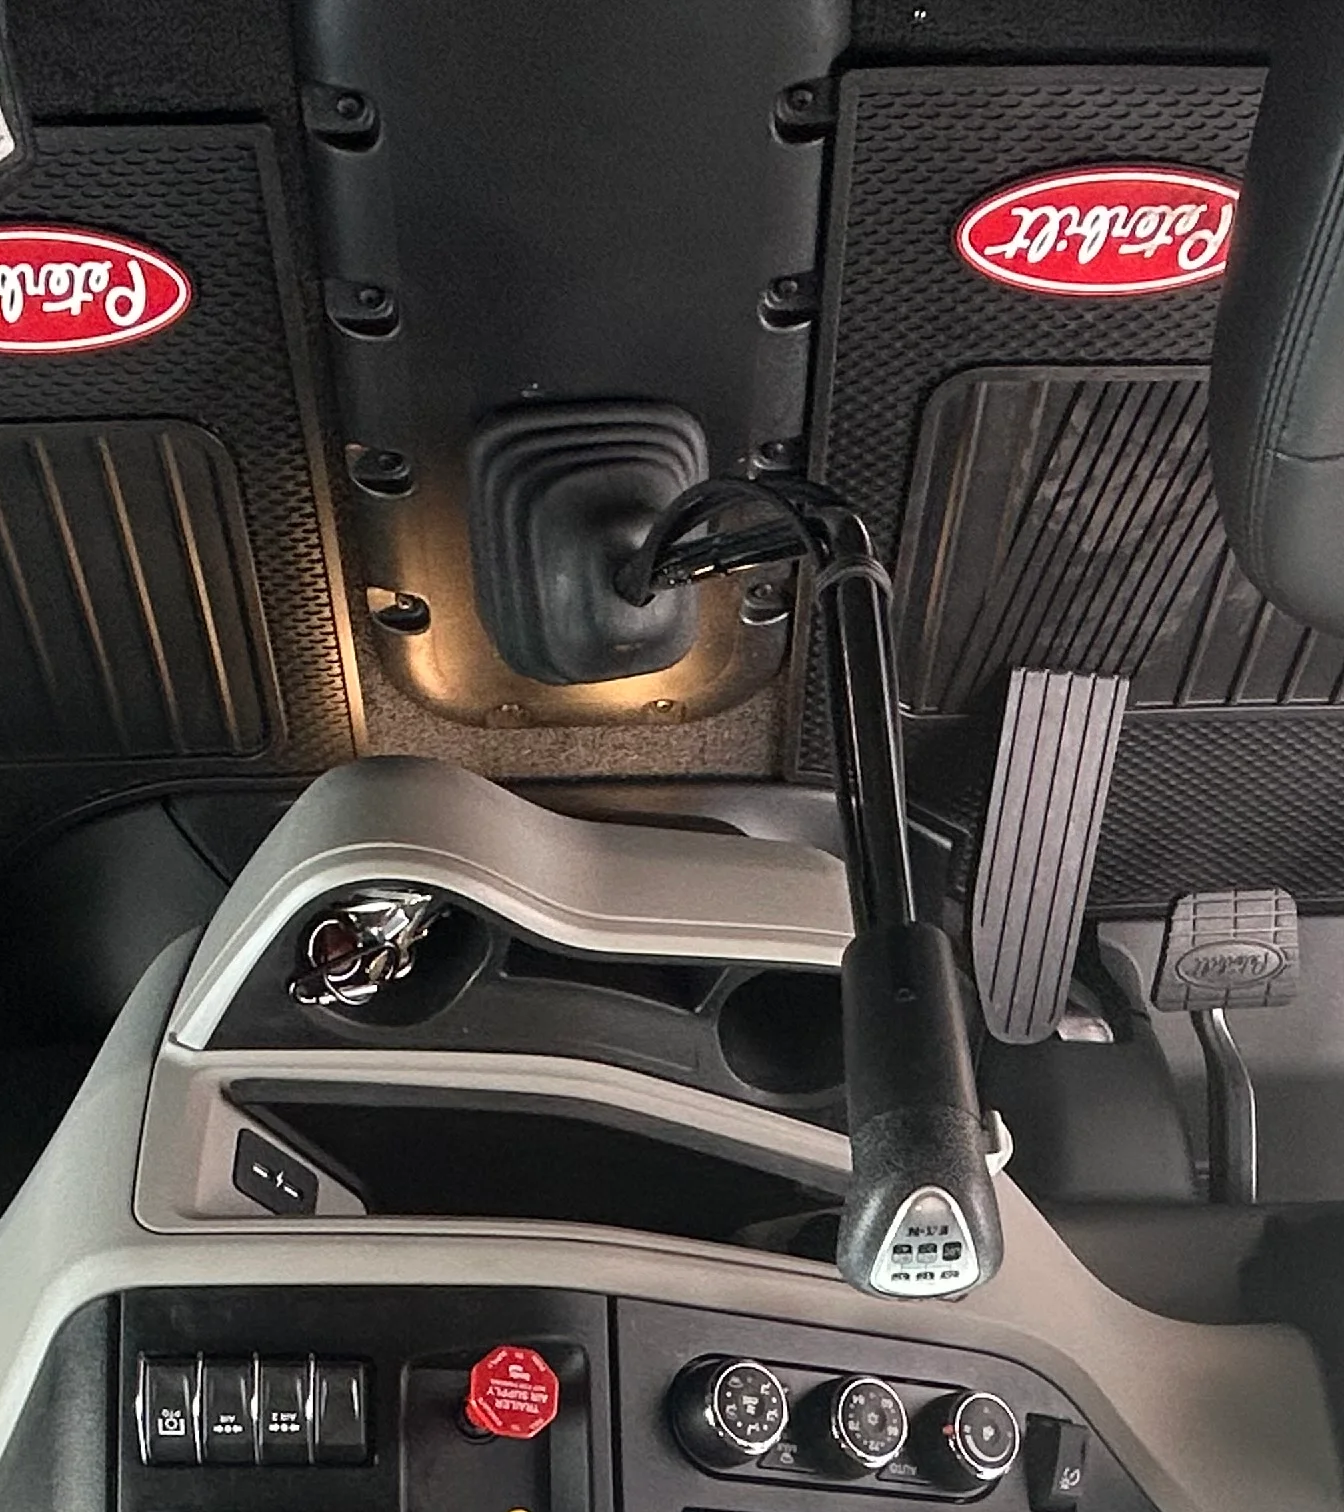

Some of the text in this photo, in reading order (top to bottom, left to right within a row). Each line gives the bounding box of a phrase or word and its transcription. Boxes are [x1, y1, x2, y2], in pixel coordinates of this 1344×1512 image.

[984, 202, 1233, 270] Peterbilt
[1183, 953, 1269, 977] Peterbilt
[486, 1386, 548, 1403] AIR SUPPLY
[494, 1397, 540, 1414] TRAILER
[868, 1440, 880, 1452] 72
[889, 1462, 918, 1476] AUTO
